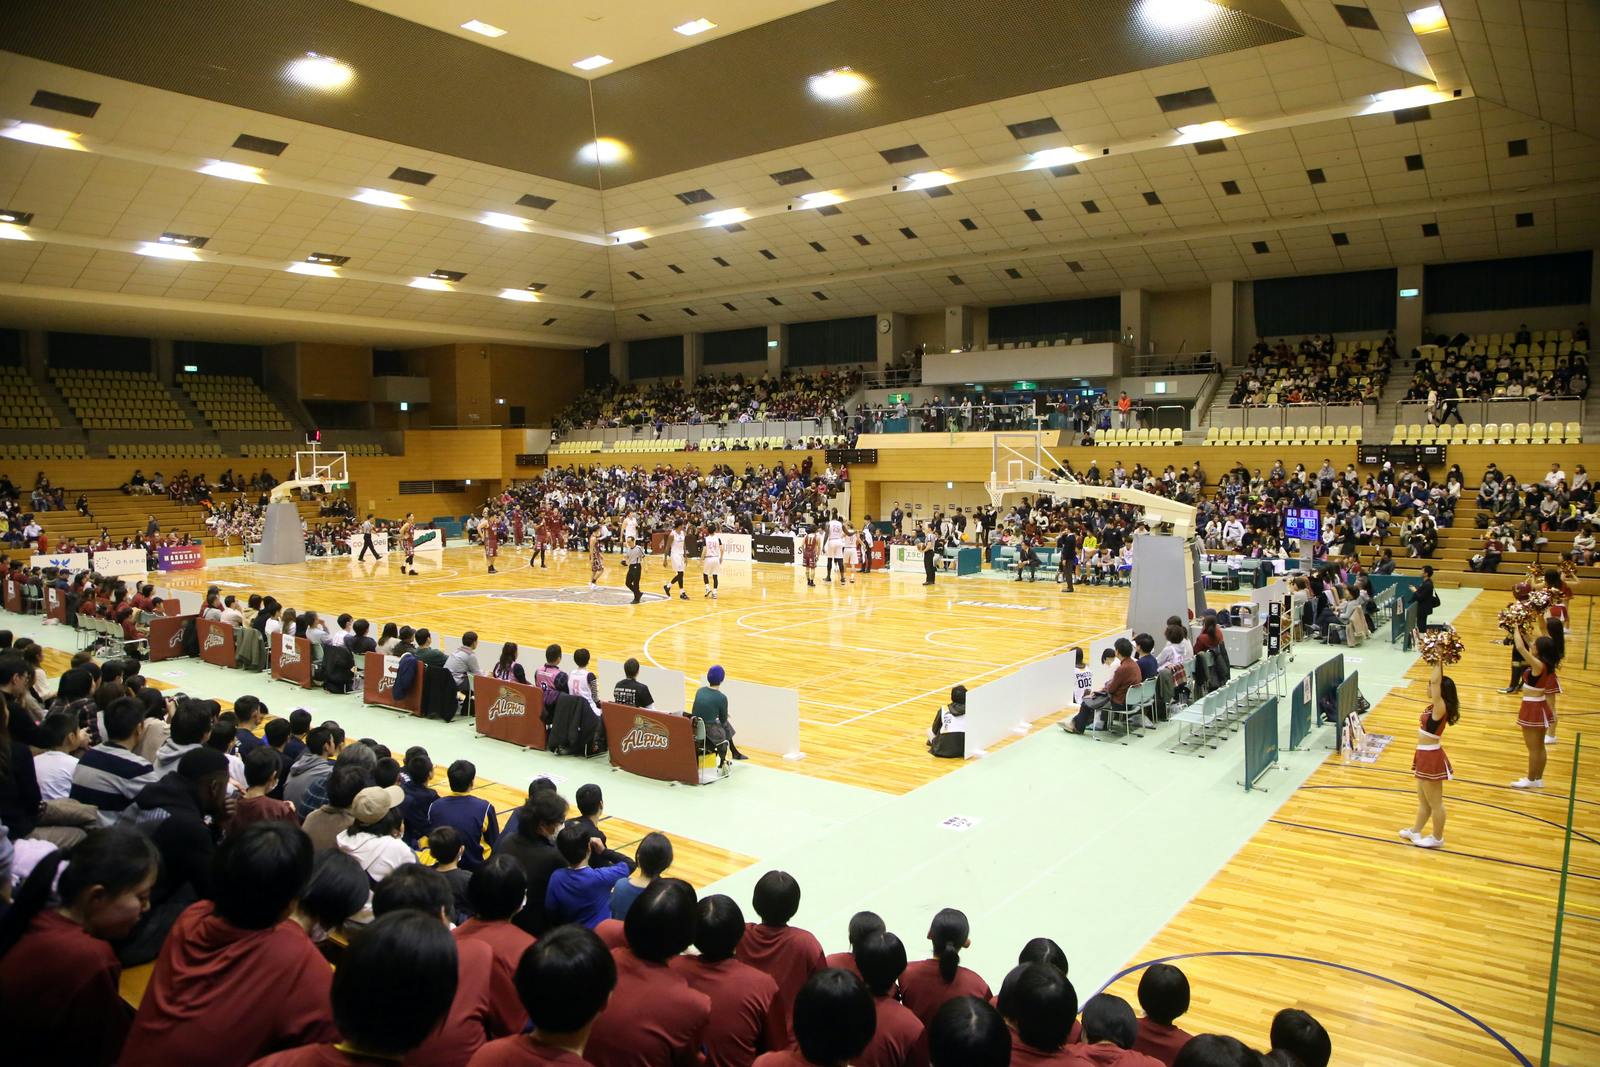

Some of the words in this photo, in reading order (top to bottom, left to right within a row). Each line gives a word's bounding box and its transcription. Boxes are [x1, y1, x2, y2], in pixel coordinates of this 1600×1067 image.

[724, 544, 744, 553] UJITSU
[764, 544, 791, 555] SoftBank
[621, 729, 668, 753] ALPHAS
